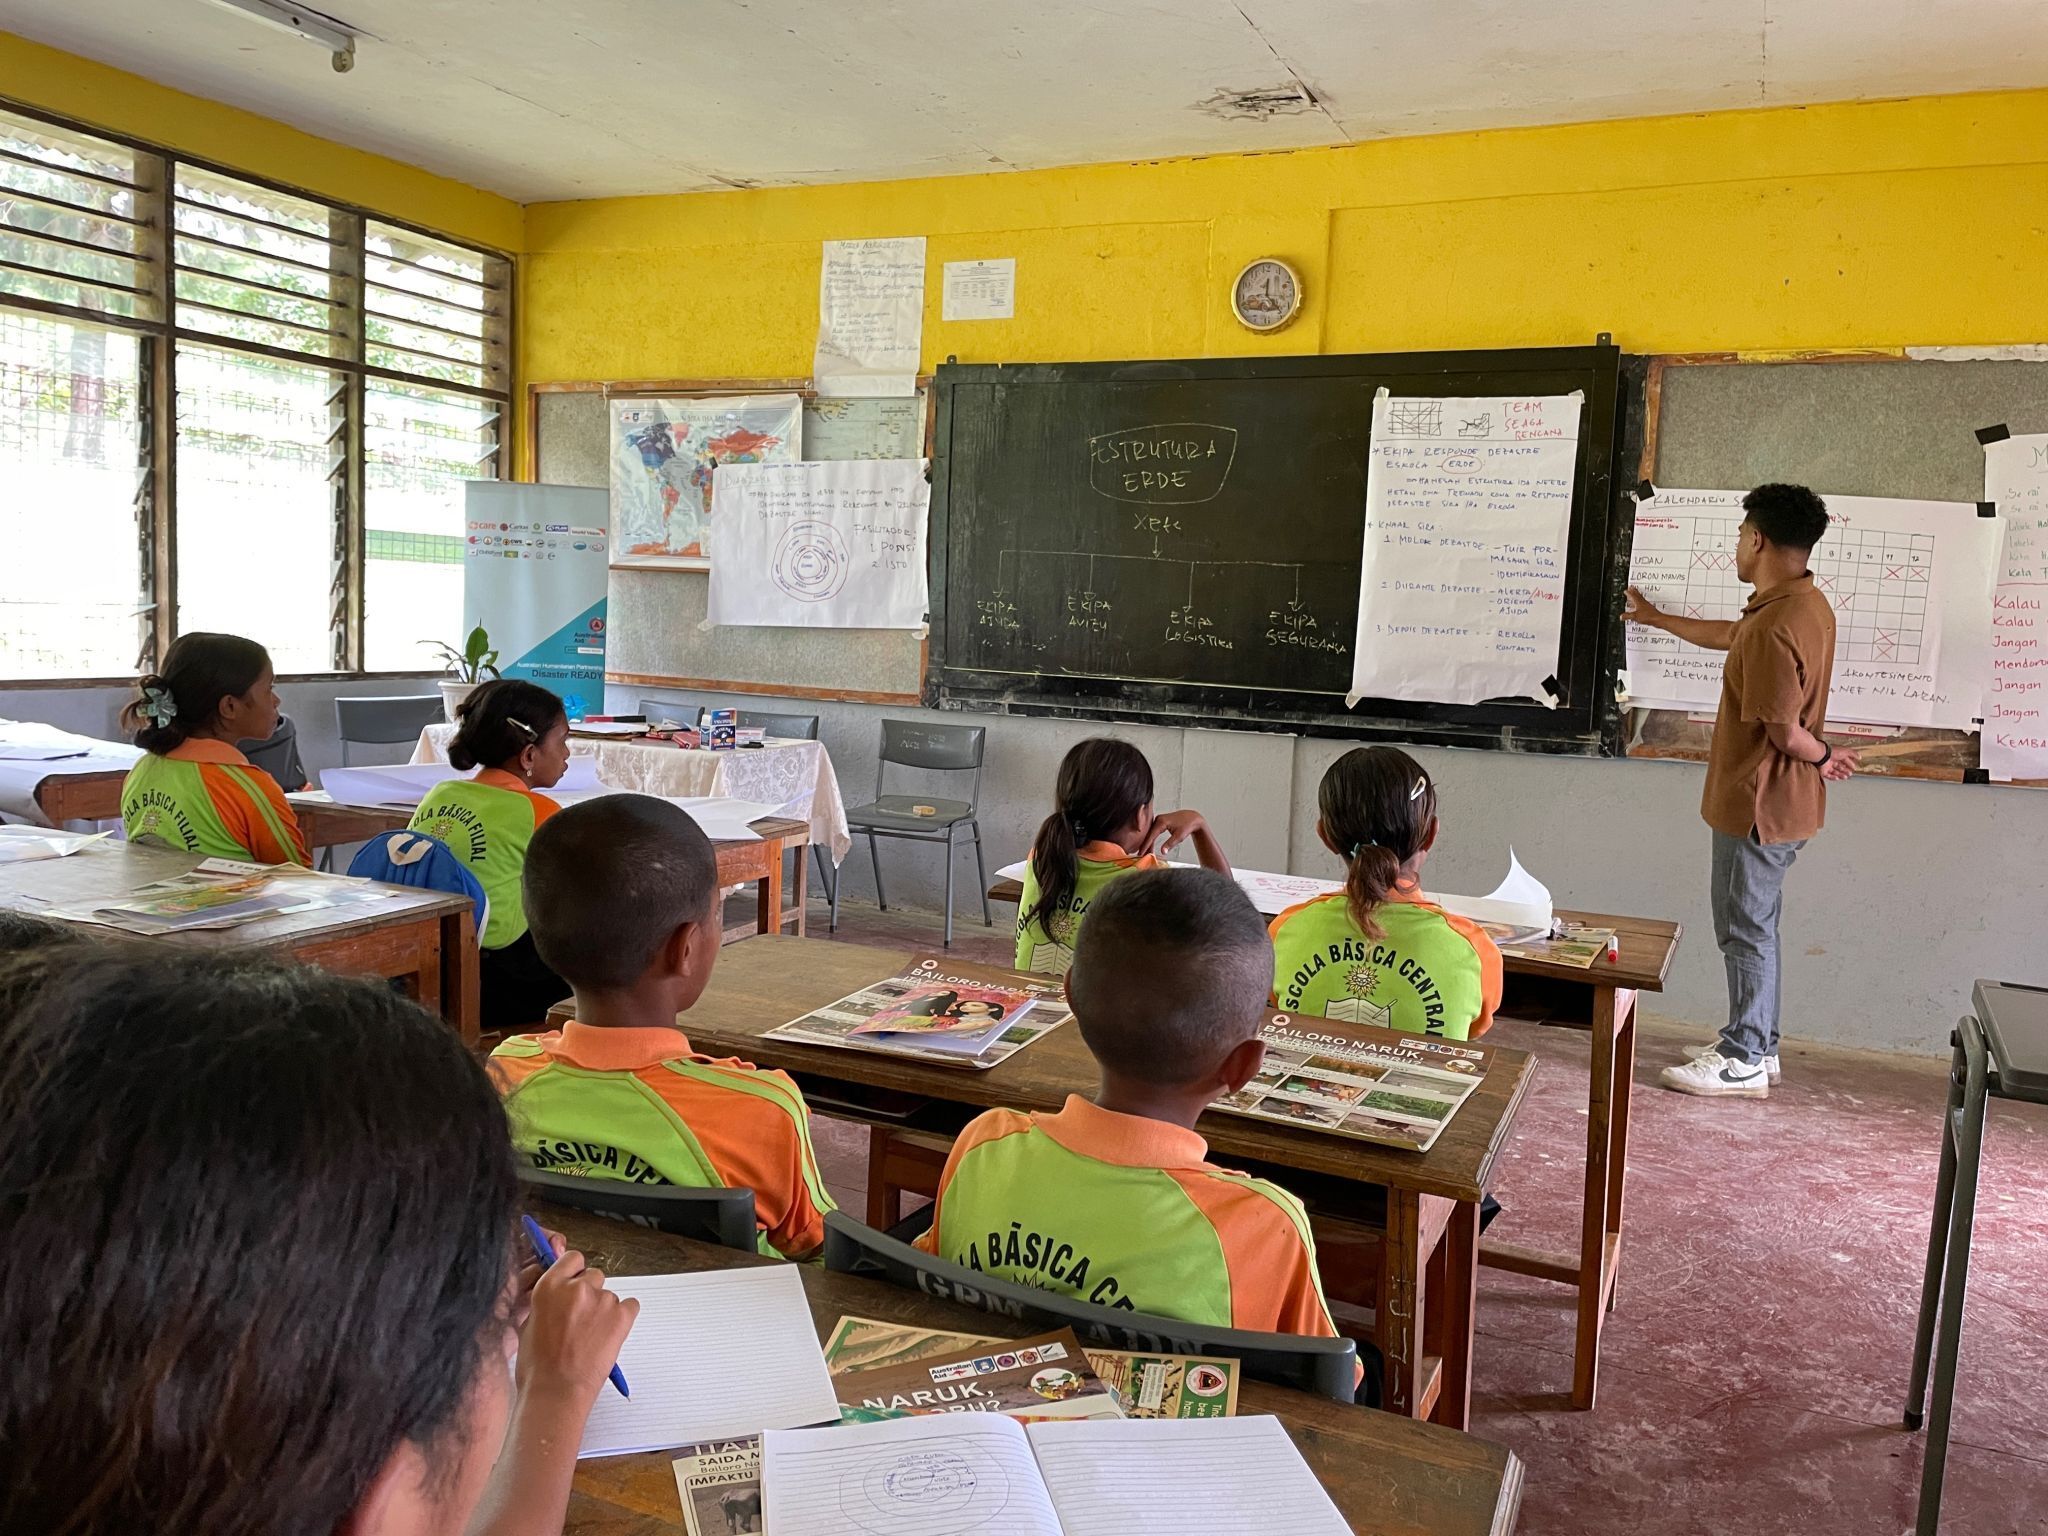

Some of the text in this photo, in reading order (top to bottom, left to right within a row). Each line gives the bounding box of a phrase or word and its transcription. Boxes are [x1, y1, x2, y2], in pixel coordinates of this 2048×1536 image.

[1503, 402, 1543, 417] TEAM
[1384, 447, 1540, 457] EKIPA RESPONDE DEZASTRE
[1386, 460, 1474, 469] ESKOLA ERDE
[1122, 470, 1192, 492] ERDE
[1631, 571, 1659, 580] LORON
[1068, 596, 1112, 614] EKIPA
[1994, 595, 2041, 610] Kalau
[1170, 611, 1214, 629] EKIPA
[1269, 611, 1317, 630] EKIPA
[1992, 615, 2034, 627] Kalau
[1992, 635, 2037, 654] Jangan
[532, 670, 602, 679] Disaster READY
[1991, 678, 2041, 694] Jangan
[1989, 705, 2039, 723] Jangan
[174, 810, 200, 851] FILIAL
[468, 822, 487, 863] FILIAL
[910, 968, 980, 988] BAILORO
[1286, 953, 1326, 1013] SCOLA
[1263, 1025, 1347, 1045] BAILORO
[931, 1362, 972, 1374] Australian
[1198, 1402, 1208, 1416] bee
[699, 1454, 746, 1466] SAIDA
[700, 1464, 741, 1473] Bailoro
[690, 1471, 753, 1486] IMPAKTU
